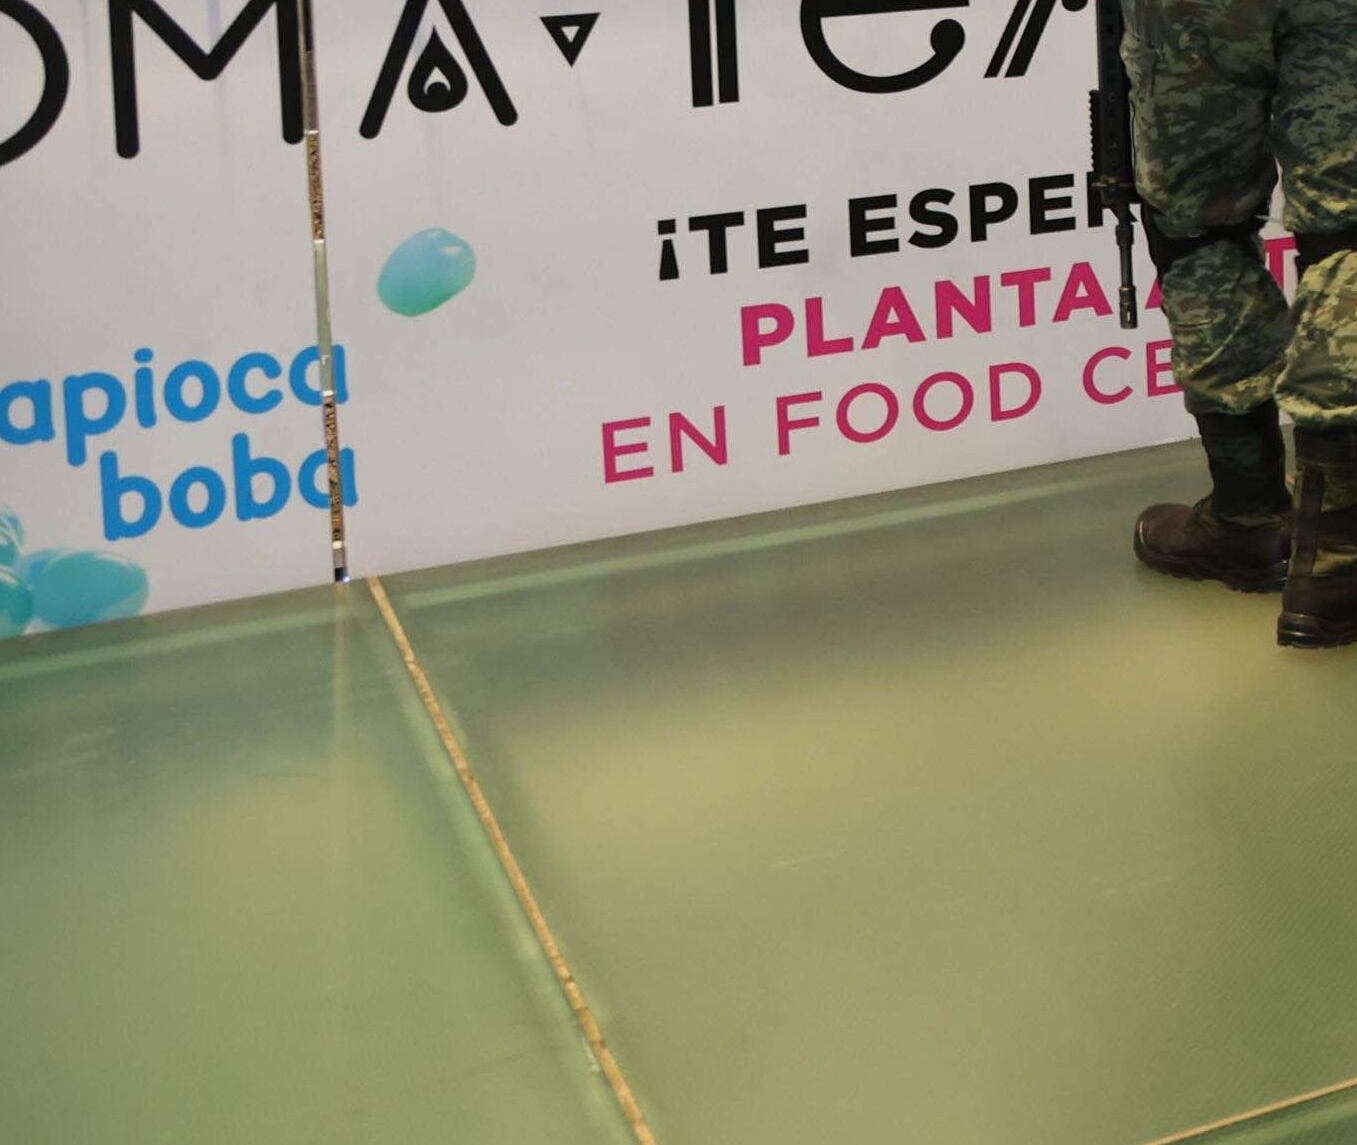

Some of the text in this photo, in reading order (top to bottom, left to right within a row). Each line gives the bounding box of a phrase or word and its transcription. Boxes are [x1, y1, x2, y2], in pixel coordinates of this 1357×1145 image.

[657, 204, 810, 281] ¡TE
[740, 261, 1113, 366] PLANTA
[601, 405, 729, 484] EN
[776, 362, 1042, 455] FOOD
[100, 433, 359, 541] boba
